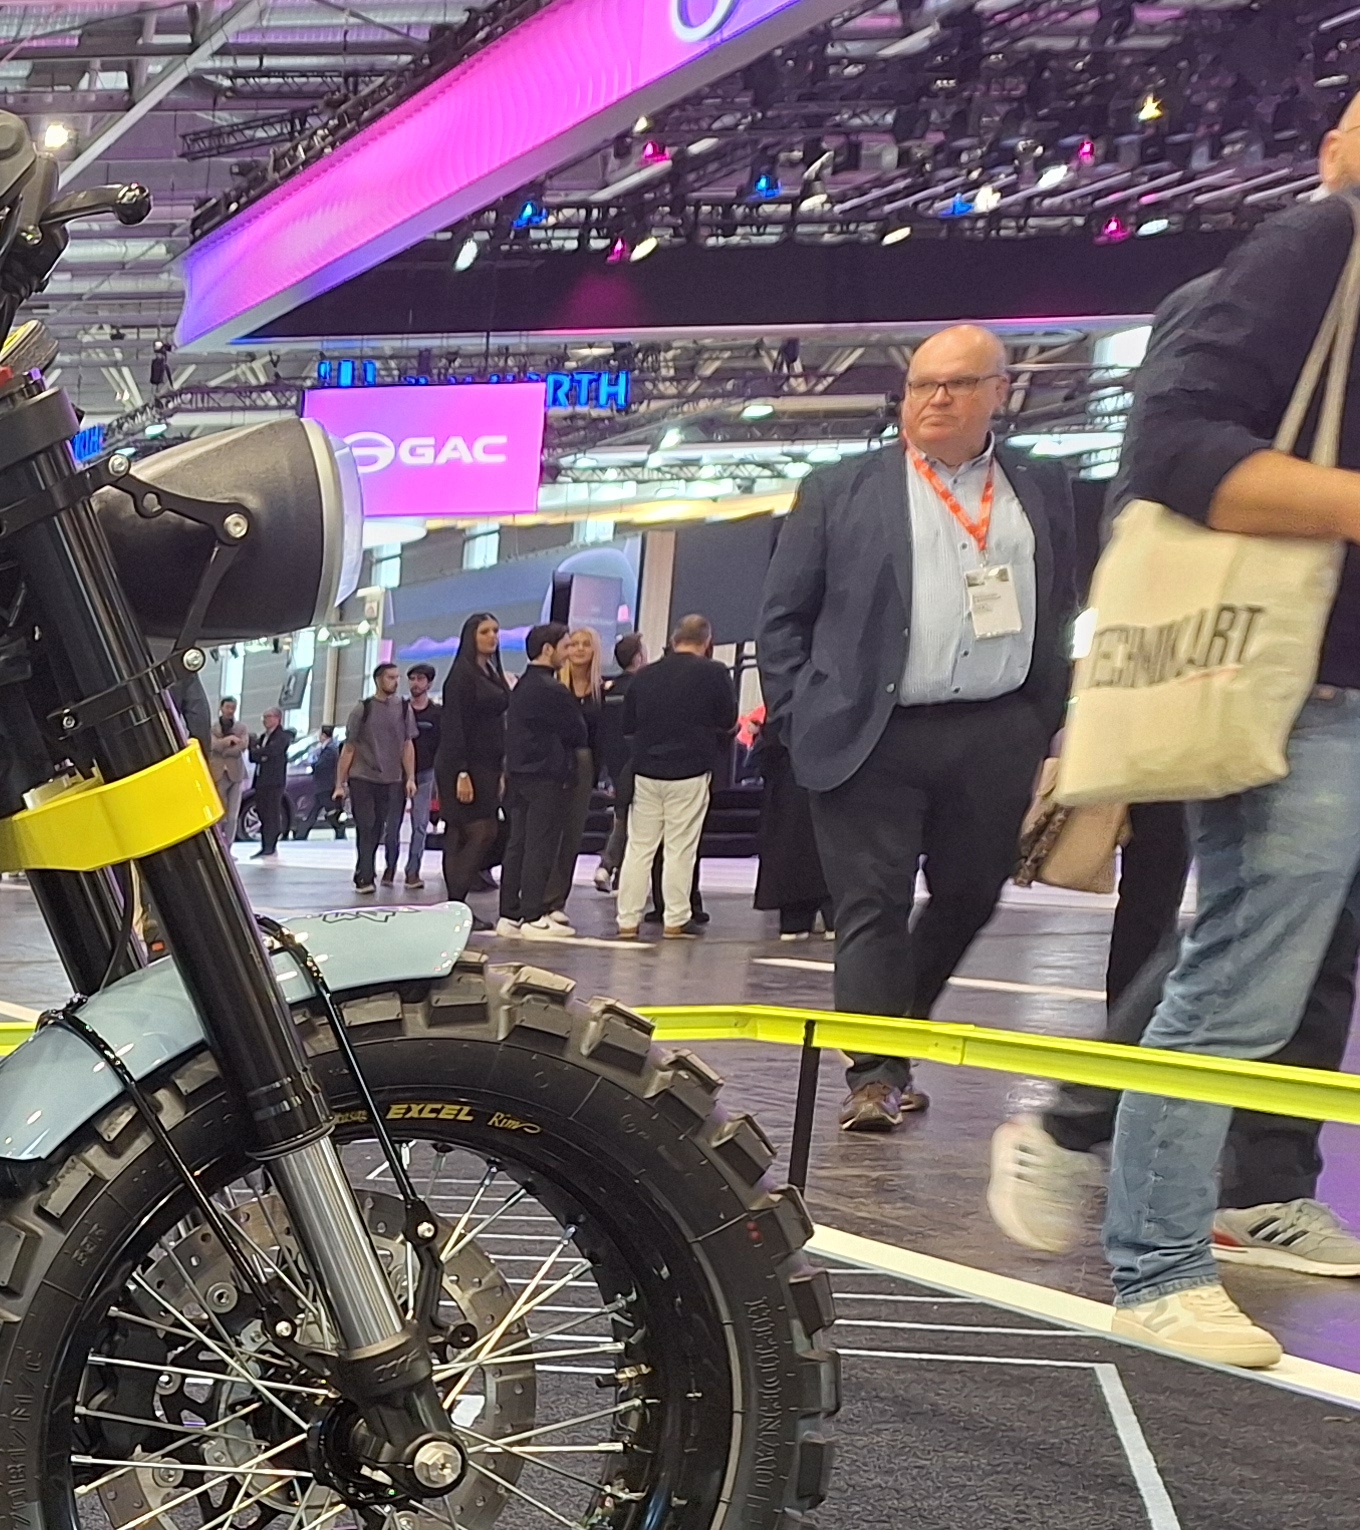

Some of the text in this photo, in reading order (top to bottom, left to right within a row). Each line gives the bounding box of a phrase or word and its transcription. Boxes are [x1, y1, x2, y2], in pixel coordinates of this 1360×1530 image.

[399, 435, 508, 465] GAC
[385, 1103, 475, 1122] EXCEL
[487, 1111, 542, 1134] Rim
